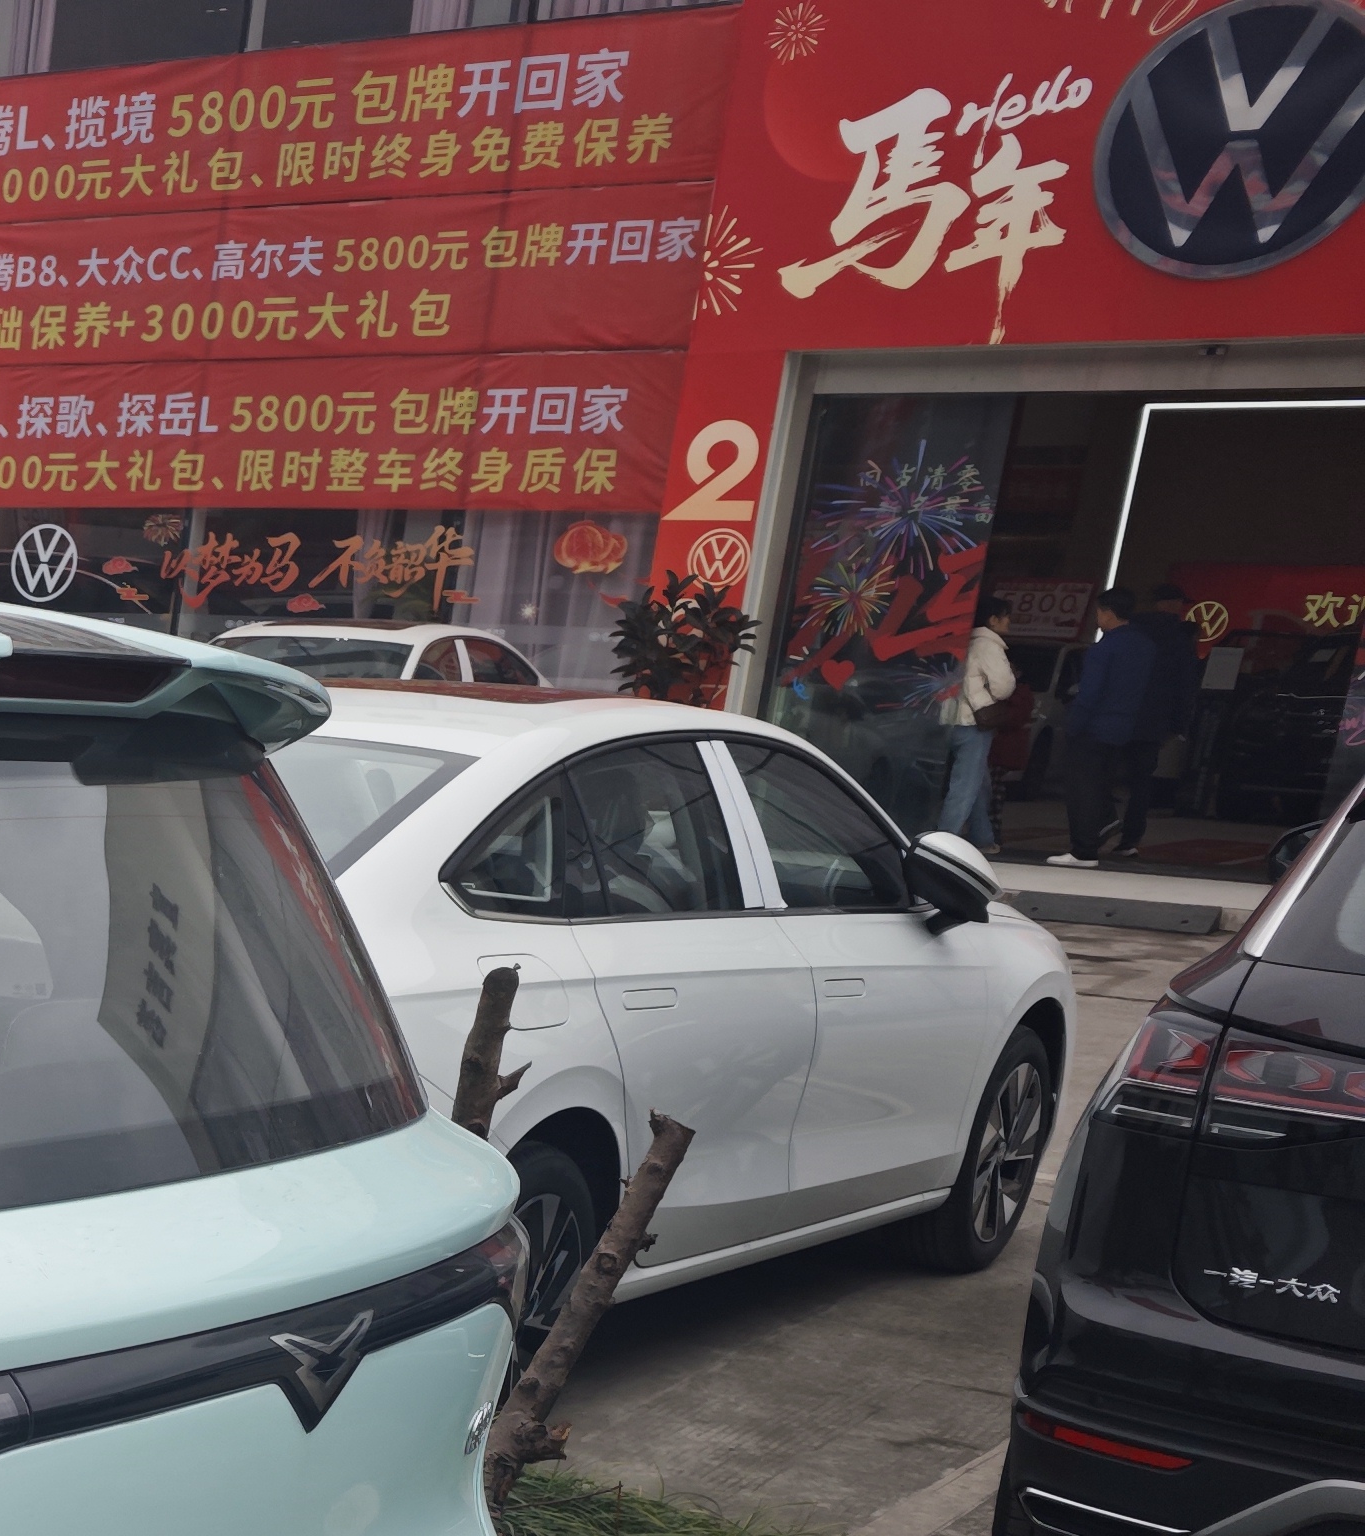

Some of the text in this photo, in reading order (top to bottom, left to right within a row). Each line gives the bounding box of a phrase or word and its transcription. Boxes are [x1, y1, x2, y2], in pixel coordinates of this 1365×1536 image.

[168, 77, 335, 138] 5800元
[351, 48, 630, 127] 包牌开回家
[956, 66, 1094, 170] Hello
[333, 231, 469, 275] 5800元
[482, 217, 701, 269] 包牌开回家
[230, 391, 376, 436] 5800元
[389, 384, 629, 436] 包牌开回家
[160, 531, 302, 609] 以梦为马
[308, 525, 475, 612] 不负韶华
